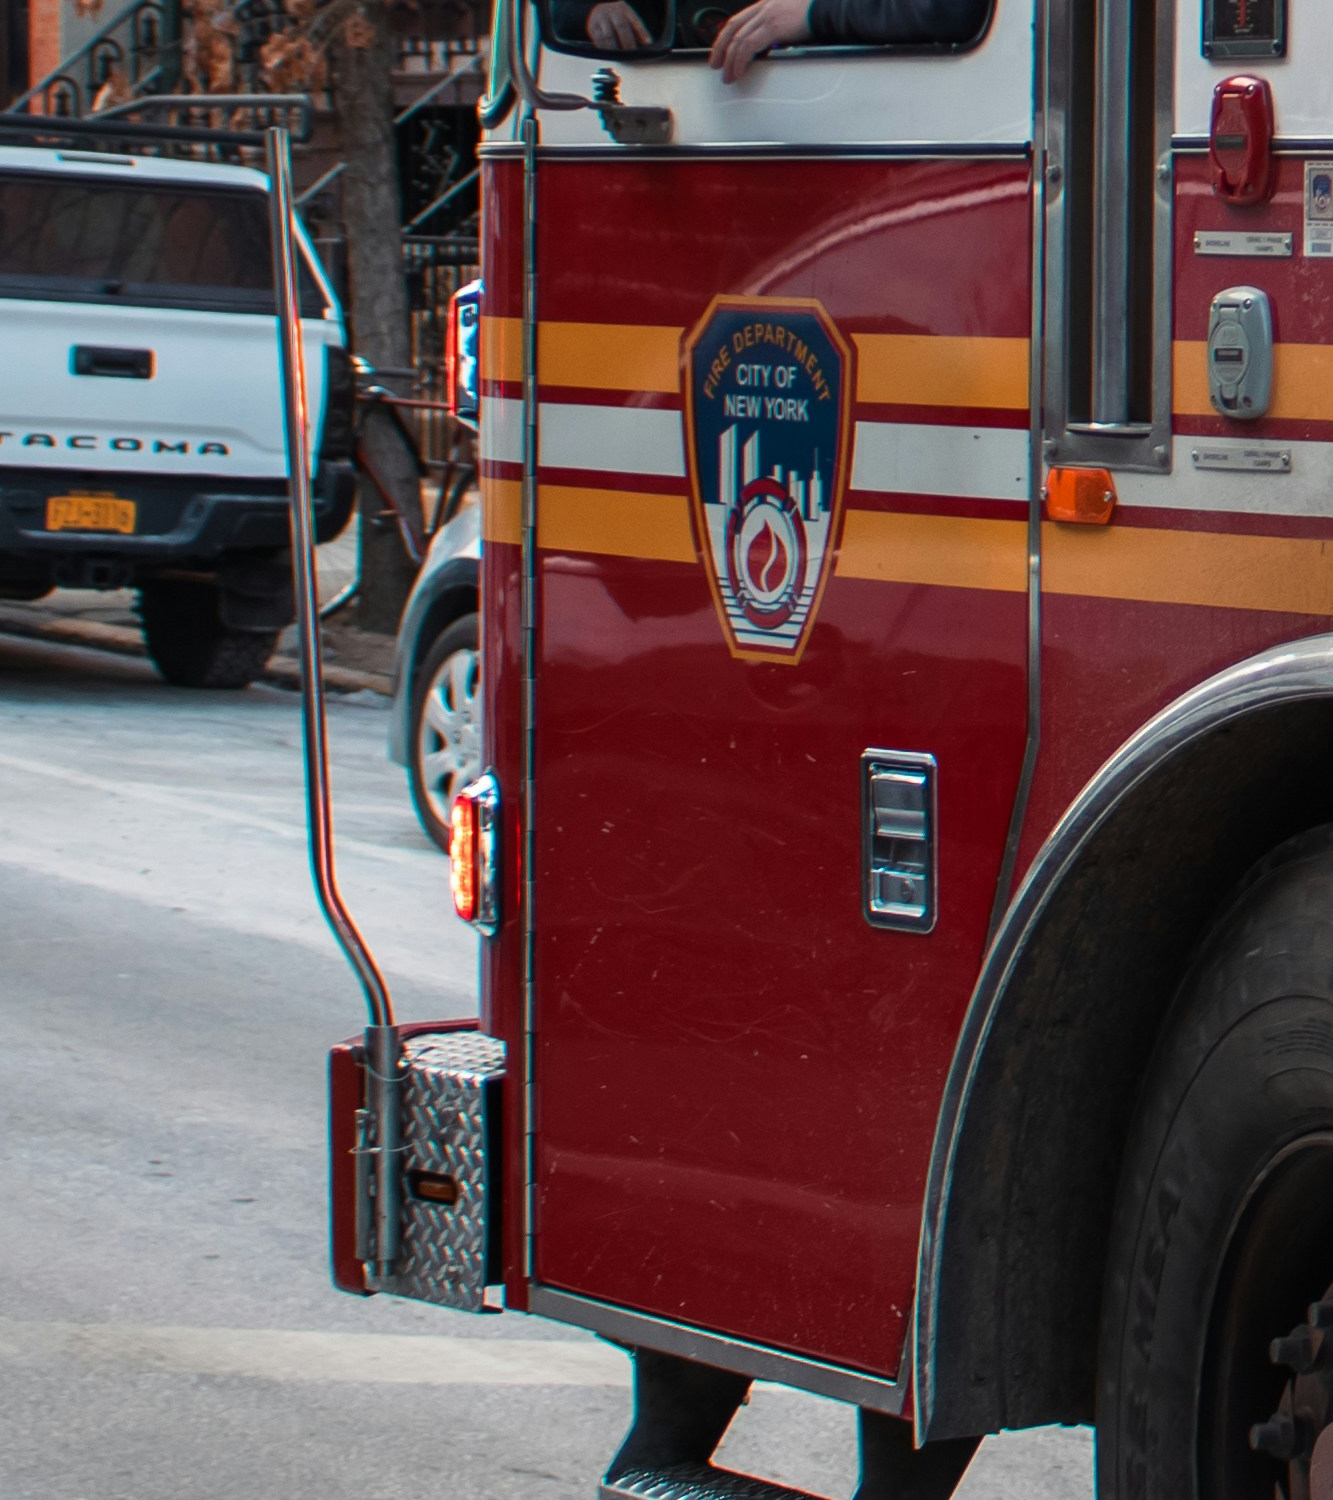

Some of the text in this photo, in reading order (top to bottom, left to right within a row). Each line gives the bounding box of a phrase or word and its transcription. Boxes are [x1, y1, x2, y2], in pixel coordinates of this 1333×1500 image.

[704, 323, 831, 401] FIRE DEPARTMENT
[736, 363, 798, 389] CITY OF
[723, 394, 809, 422] NEW YORK
